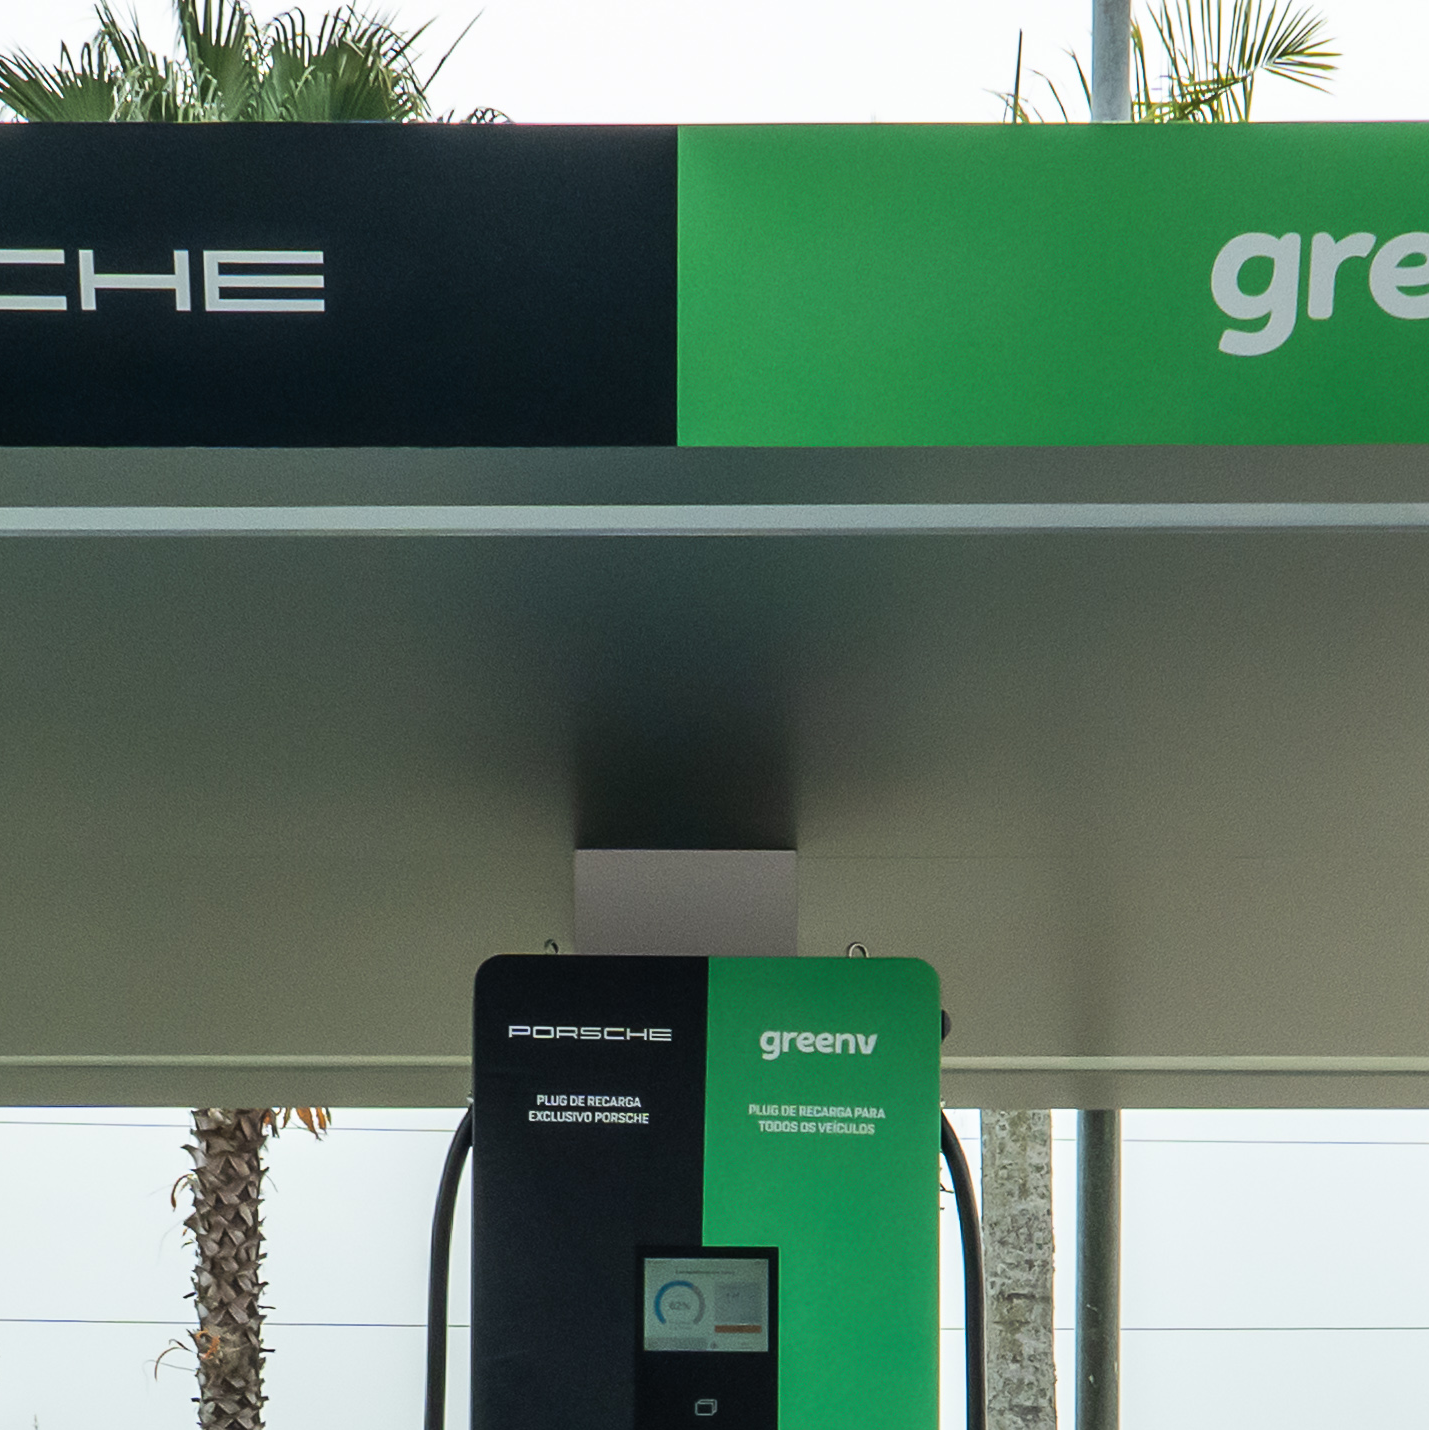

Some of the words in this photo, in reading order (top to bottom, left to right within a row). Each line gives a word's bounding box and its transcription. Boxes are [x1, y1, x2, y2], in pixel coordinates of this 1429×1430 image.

[508, 1025, 673, 1042] PORSCHE
[759, 1030, 878, 1061] greenv
[536, 1094, 568, 1106] PLUG
[570, 1095, 585, 1106] DE
[587, 1096, 642, 1108] RECARGA
[528, 1110, 592, 1123] EXCLUSIVO
[594, 1112, 650, 1124] PORSCHE
[748, 1104, 779, 1116] PLUG
[781, 1105, 796, 1117] DE
[799, 1106, 853, 1118] RECARGA
[854, 1107, 886, 1119] PARA
[758, 1120, 798, 1133] TODOS
[800, 1122, 816, 1133] OS
[818, 1120, 875, 1135] VEÍCULOS
